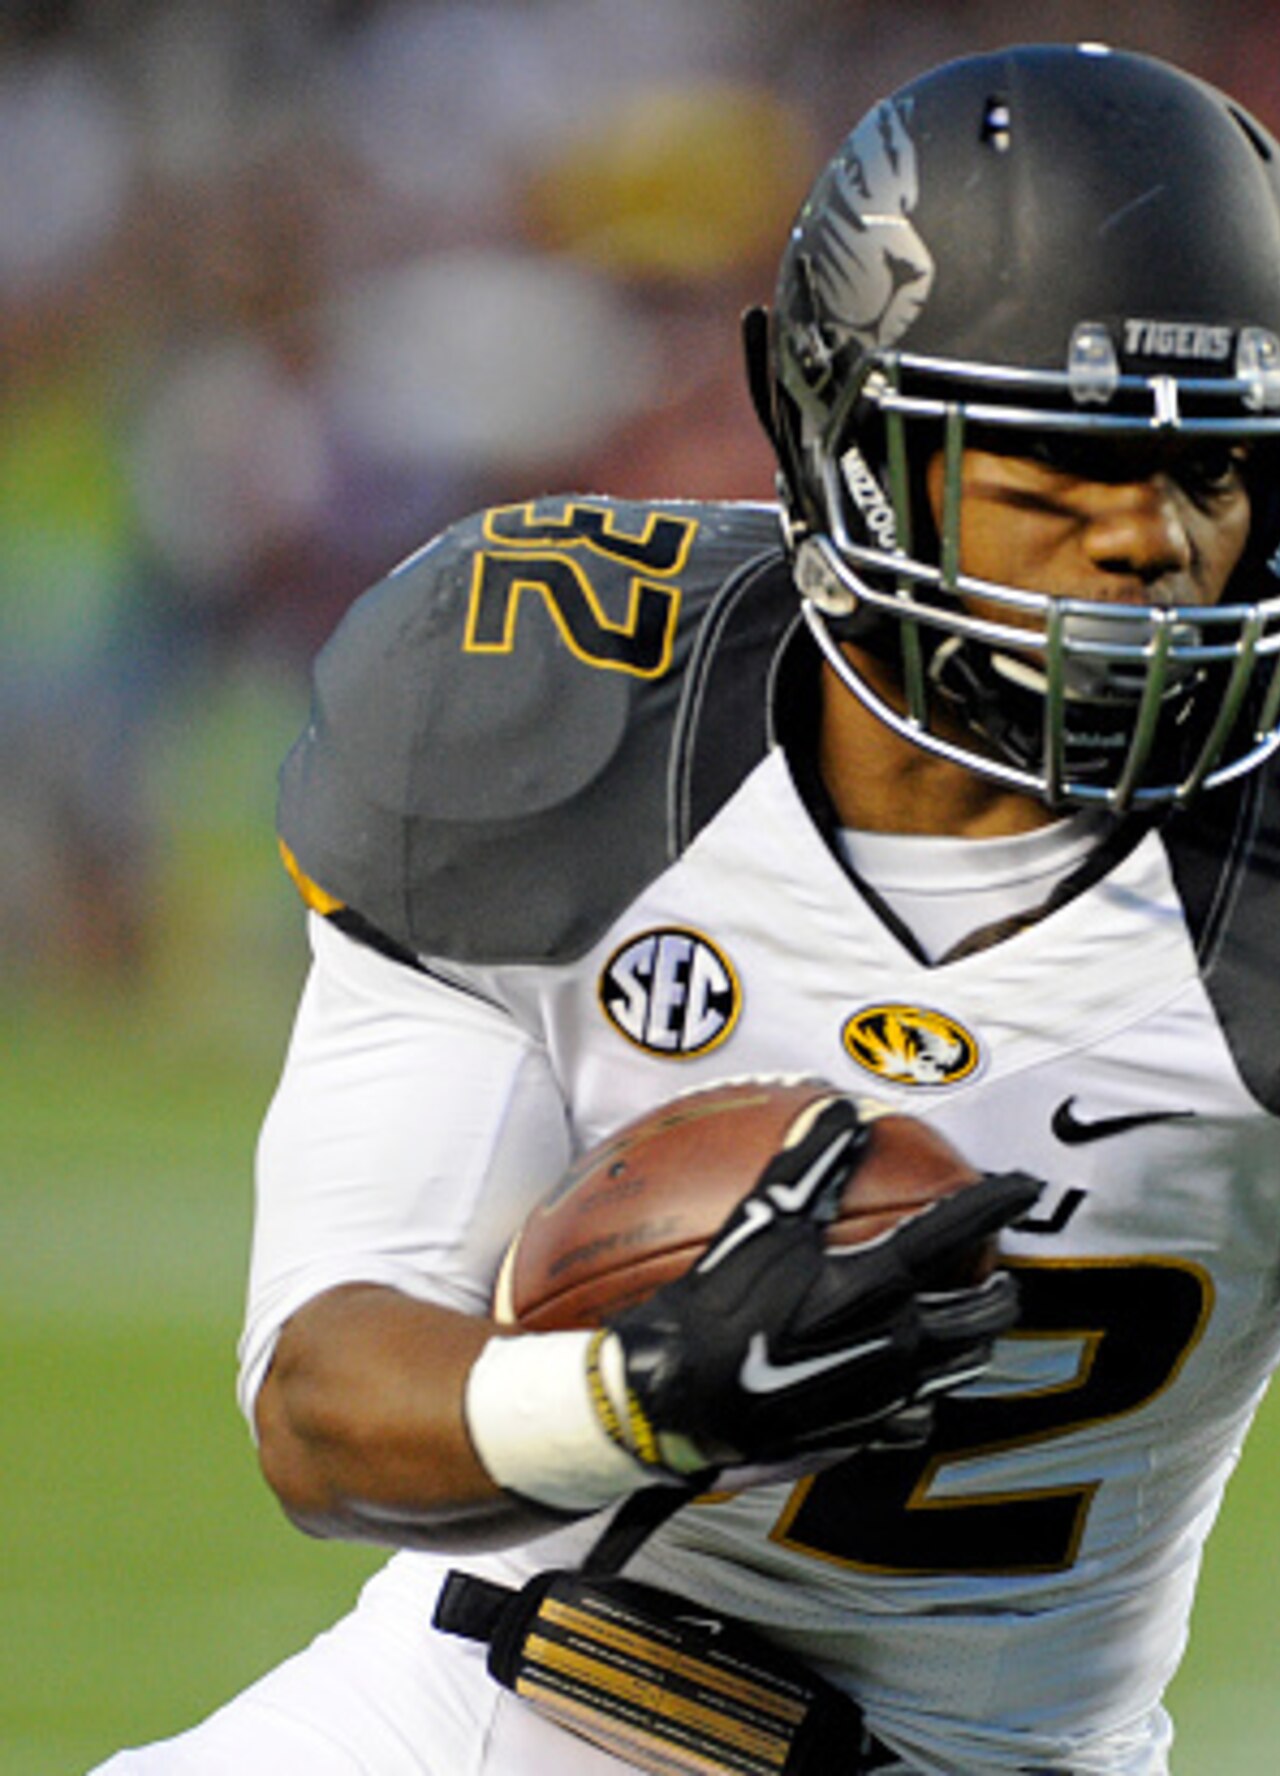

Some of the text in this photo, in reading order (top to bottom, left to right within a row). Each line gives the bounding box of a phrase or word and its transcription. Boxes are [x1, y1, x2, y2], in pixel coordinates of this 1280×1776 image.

[1124, 319, 1232, 359] TIGERS
[463, 503, 698, 679] 32
[609, 934, 730, 1051] SEC
[690, 1255, 1216, 1577] 2
